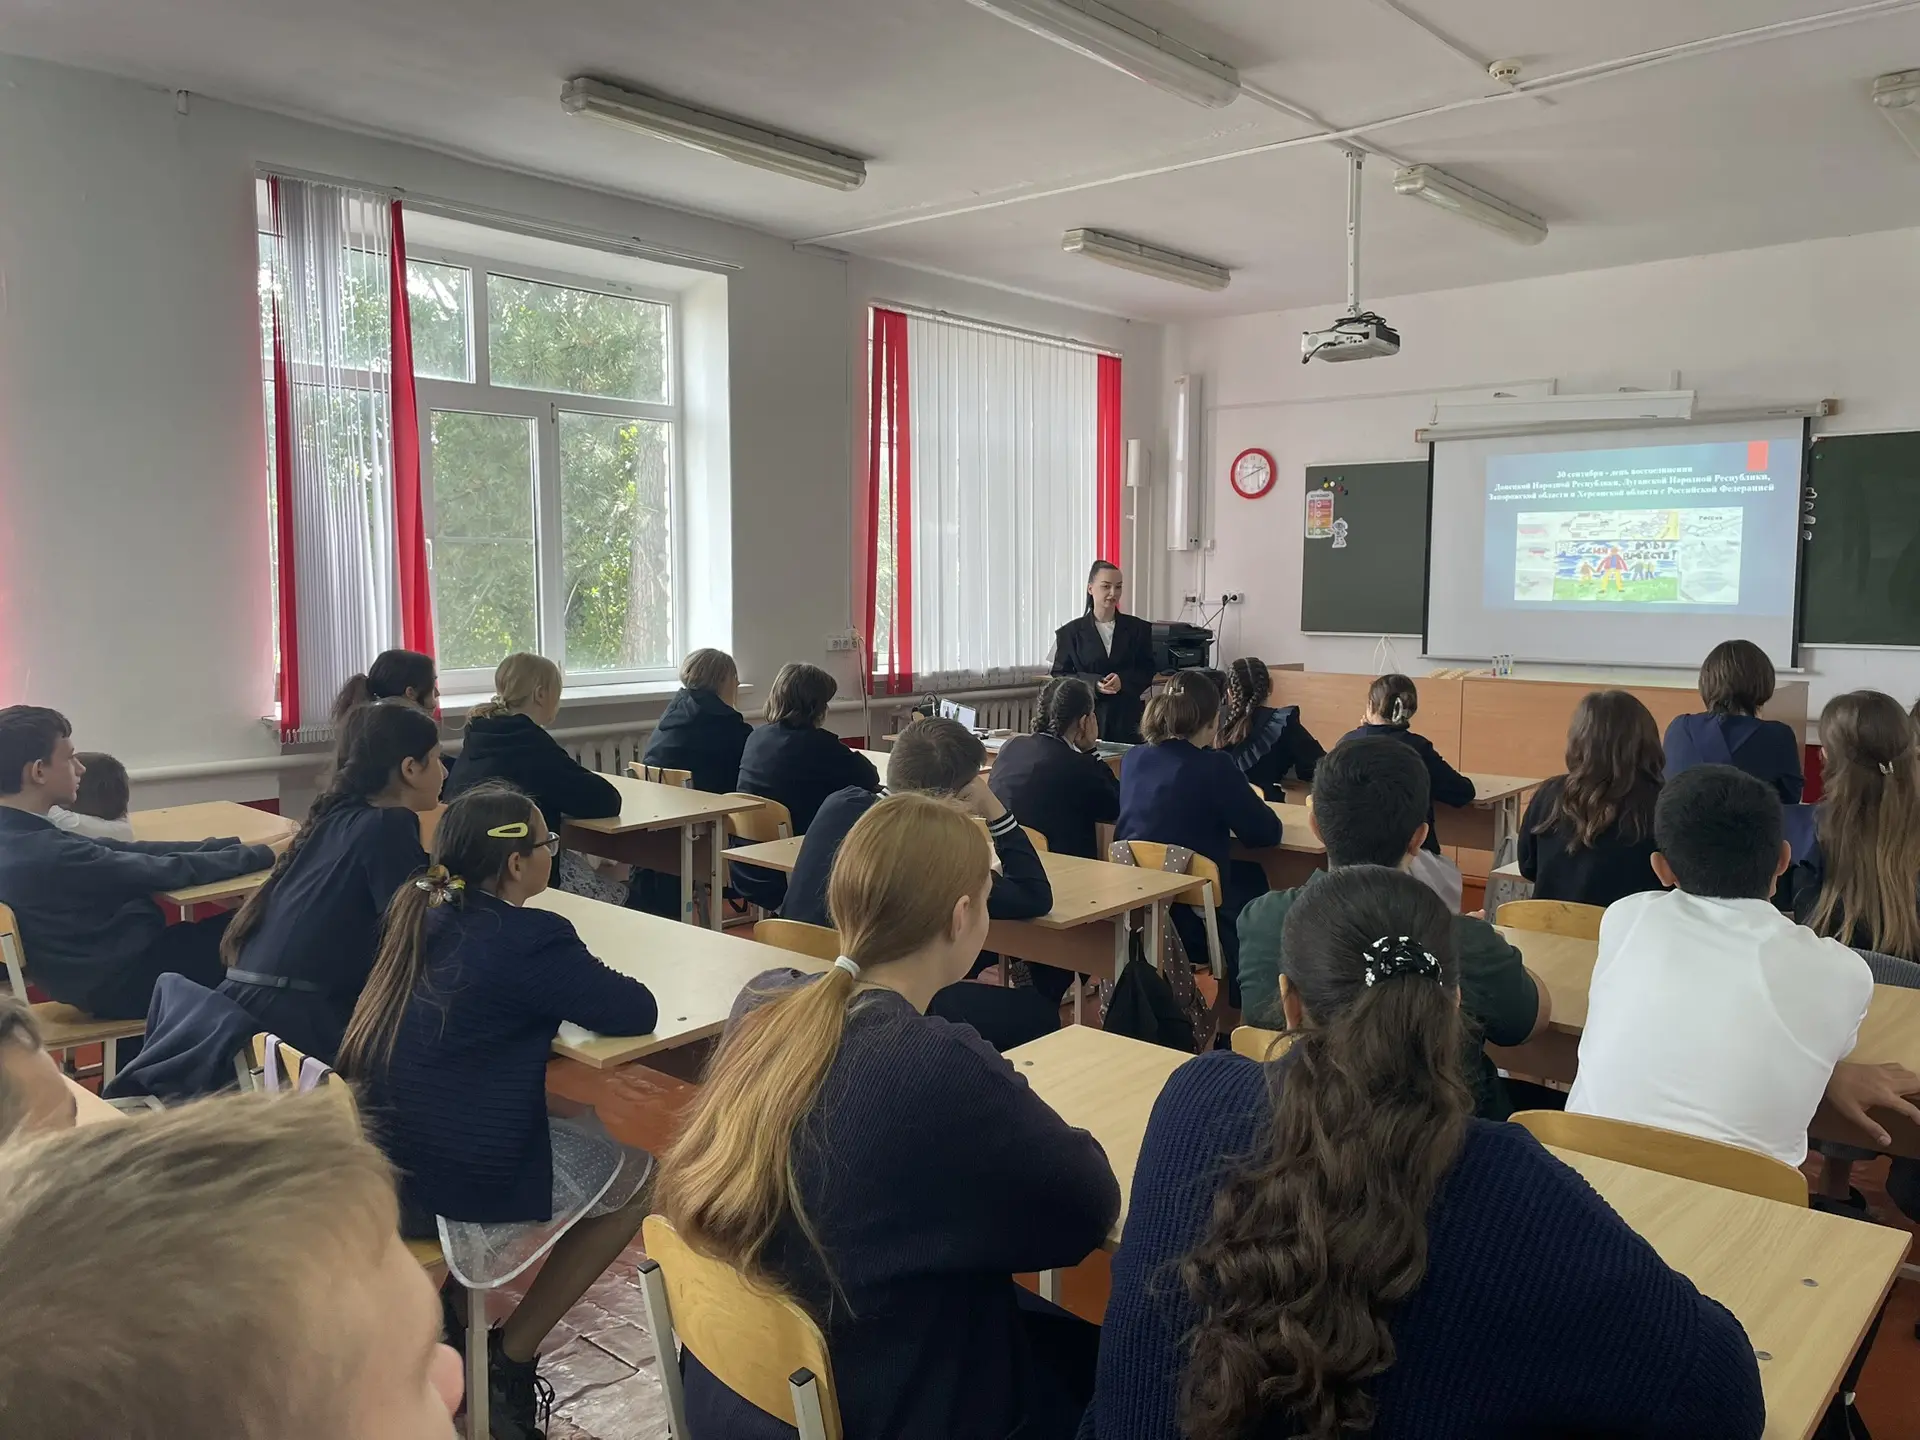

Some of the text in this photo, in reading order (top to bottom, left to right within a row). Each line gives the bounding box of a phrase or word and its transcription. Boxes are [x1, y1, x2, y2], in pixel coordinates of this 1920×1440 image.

[1532, 481, 1570, 491] Народной
[1623, 476, 1668, 488] Луганской
[1669, 475, 1712, 486] Народной
[1714, 473, 1771, 484] Республики,
[1556, 470, 1567, 478] 30
[1567, 469, 1604, 479] сентября
[1538, 490, 1569, 499] области
[1577, 489, 1625, 500] Херсонской
[1625, 488, 1659, 496] области
[1667, 485, 1718, 496] Российской
[1719, 483, 1775, 494] Федерацией
